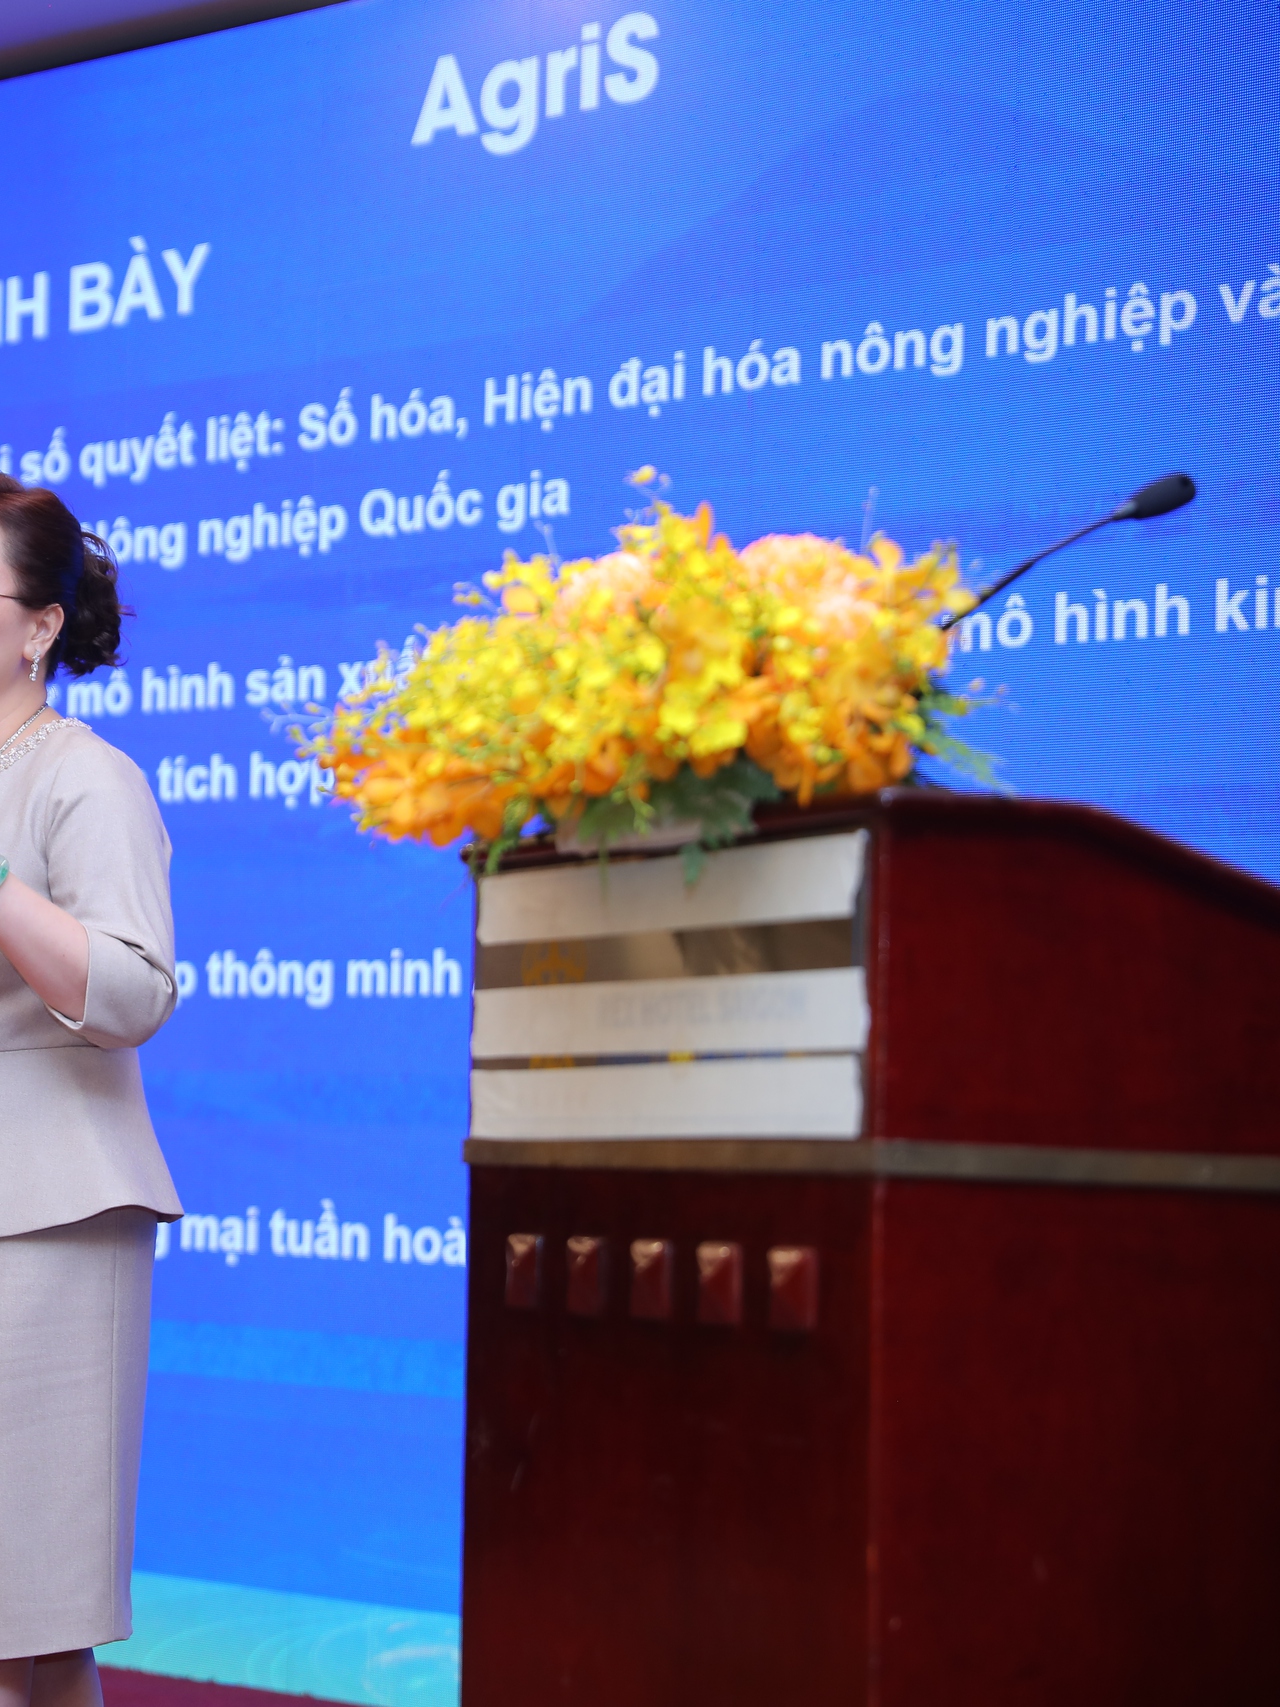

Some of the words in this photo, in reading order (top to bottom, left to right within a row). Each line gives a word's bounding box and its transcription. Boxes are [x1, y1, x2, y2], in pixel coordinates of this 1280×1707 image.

[412, 11, 658, 154] AgriS
[69, 236, 210, 333] BÀY
[19, 427, 70, 485] số
[79, 412, 195, 486] quyết
[206, 412, 284, 471] liệt:
[298, 387, 358, 450] Số
[370, 389, 468, 441] hóa,
[484, 368, 592, 431] Hiện
[609, 351, 685, 417] đại
[703, 339, 801, 396] hóa
[821, 322, 964, 380] nông
[986, 282, 1197, 363] nghiệp
[198, 496, 347, 563] nghiệp
[359, 470, 482, 537] Quốc
[497, 470, 569, 537] gia
[66, 669, 132, 717] mô
[141, 662, 234, 713] hình
[246, 655, 326, 704] sản
[1055, 583, 1190, 645] hình
[1215, 575, 1280, 633] ki
[154, 754, 237, 808] tích
[250, 751, 337, 809] hợp
[206, 949, 334, 1008] thông
[347, 948, 461, 997] minh
[180, 1206, 258, 1267] mại
[269, 1199, 369, 1260] tuần
[384, 1213, 466, 1266] hoà
